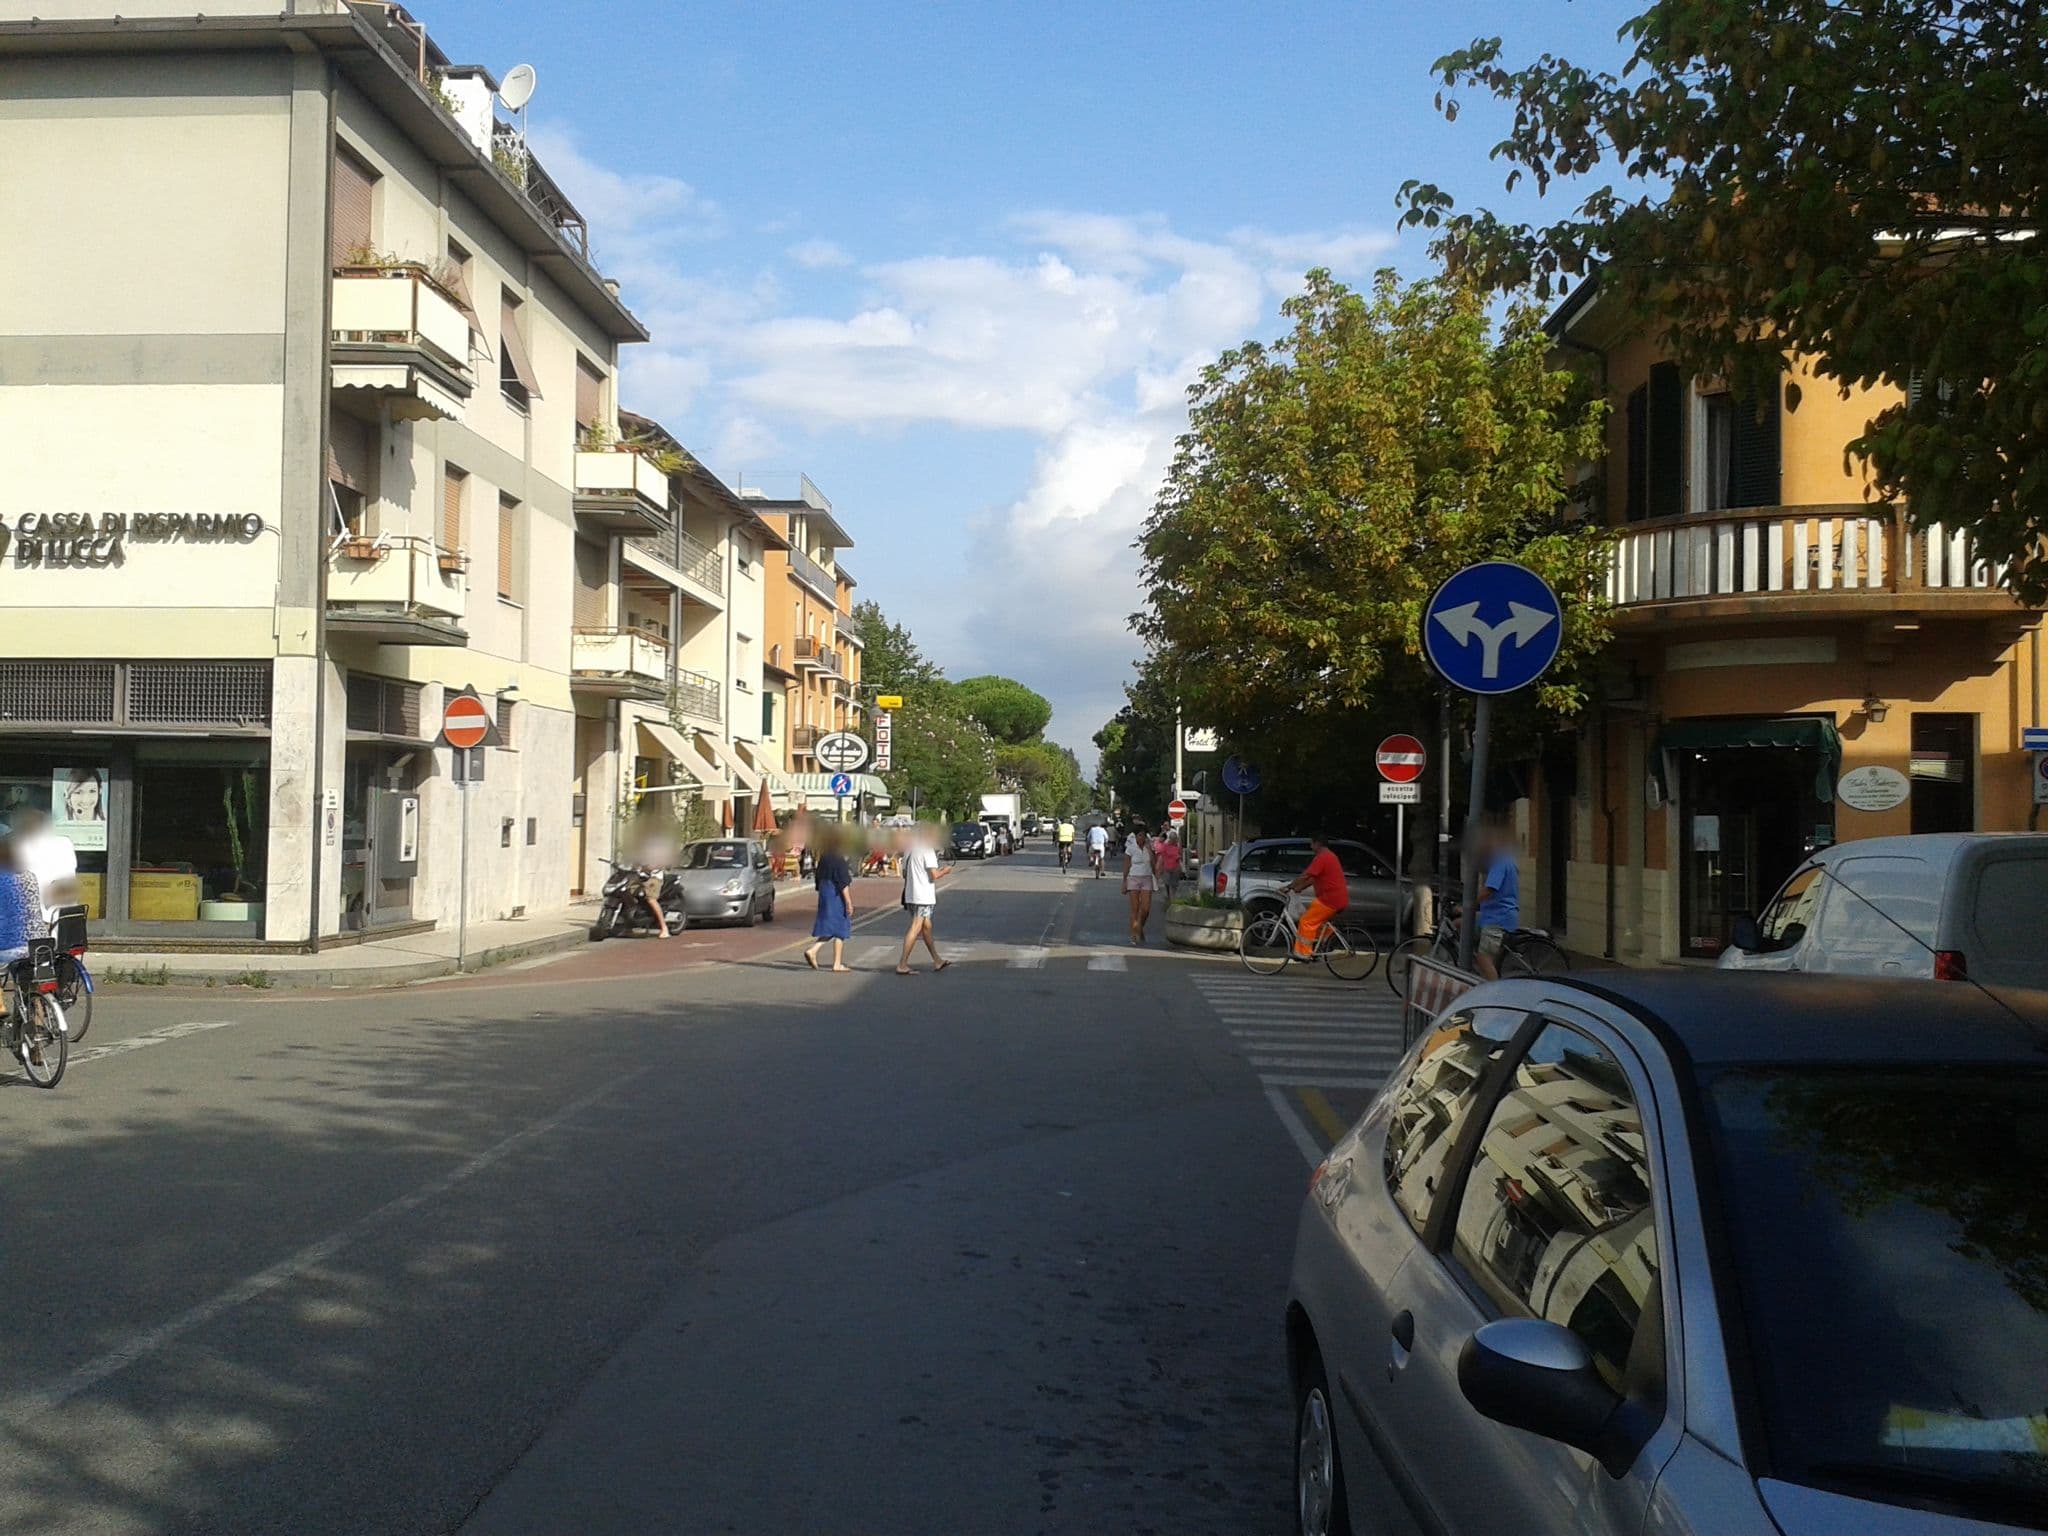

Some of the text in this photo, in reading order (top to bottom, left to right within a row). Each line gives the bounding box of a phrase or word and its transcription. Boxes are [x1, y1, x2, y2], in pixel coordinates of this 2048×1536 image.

[18, 512, 265, 536] CASSA DI RISPARMIO
[18, 538, 126, 561] DI LUCCA
[877, 715, 889, 769] FOTO
